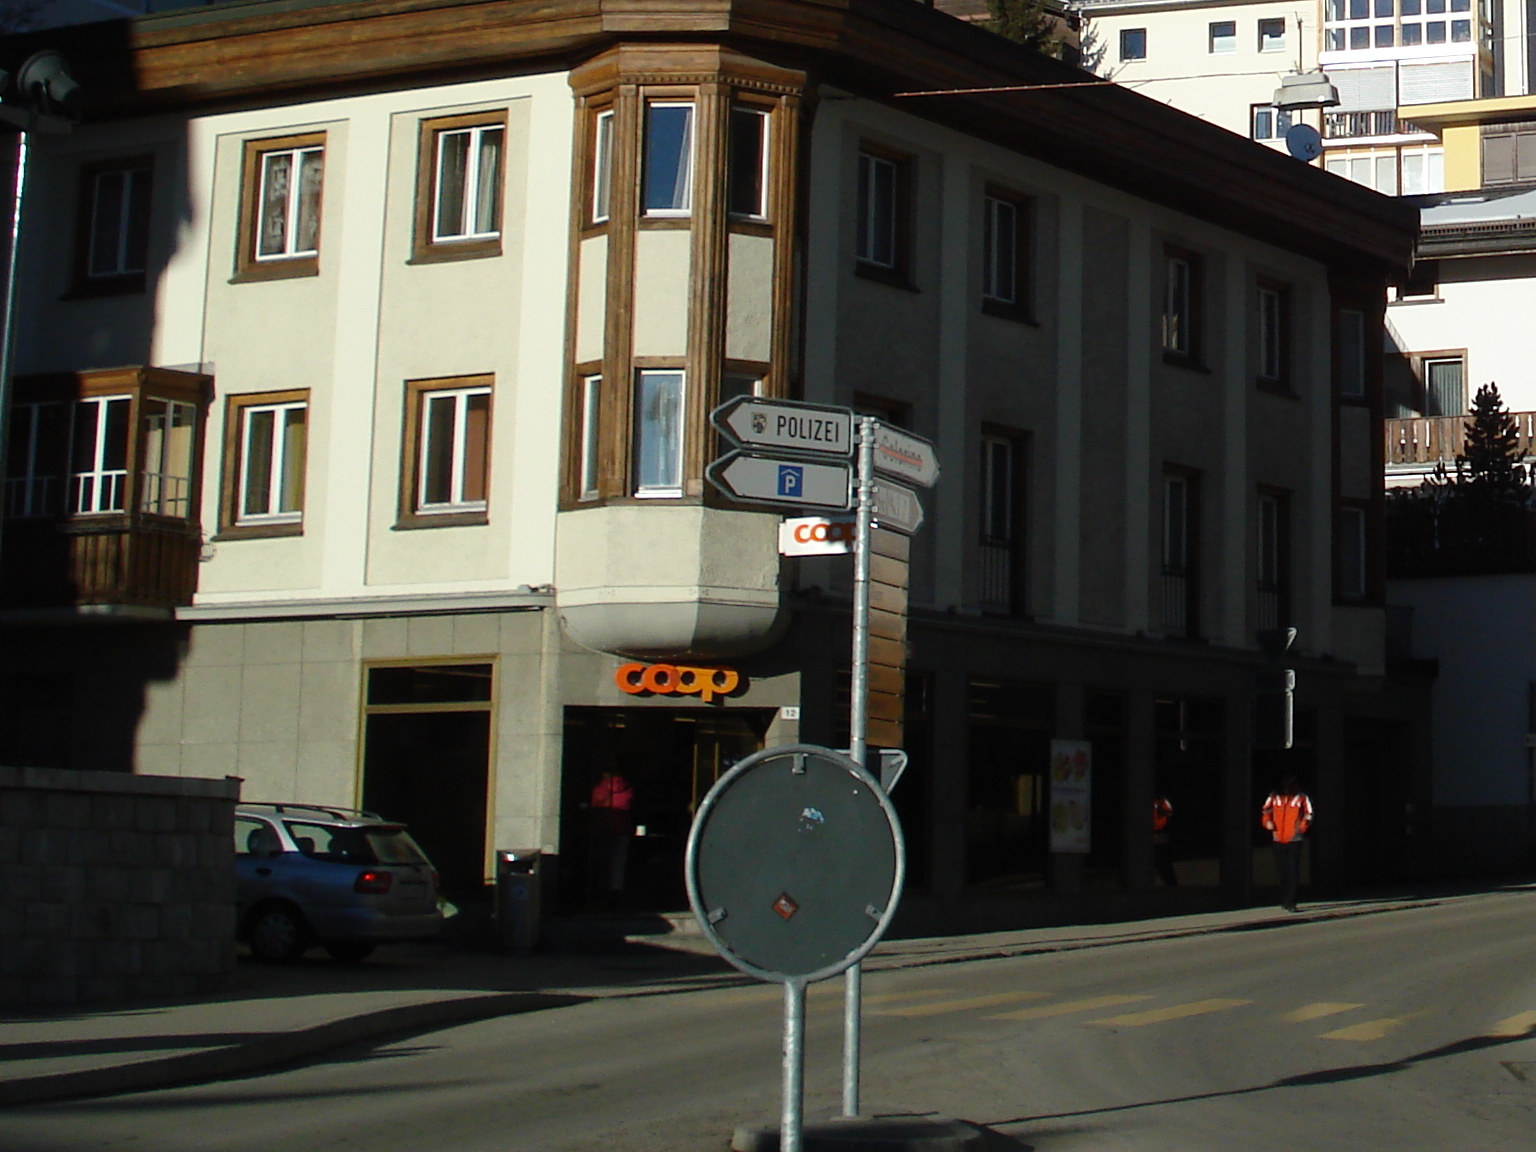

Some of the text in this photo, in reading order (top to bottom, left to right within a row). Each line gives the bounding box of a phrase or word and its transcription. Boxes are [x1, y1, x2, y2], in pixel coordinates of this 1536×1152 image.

[776, 414, 840, 444] POLIZEI
[784, 475, 797, 494] P
[615, 663, 739, 702] coop
[785, 709, 797, 717] 12
